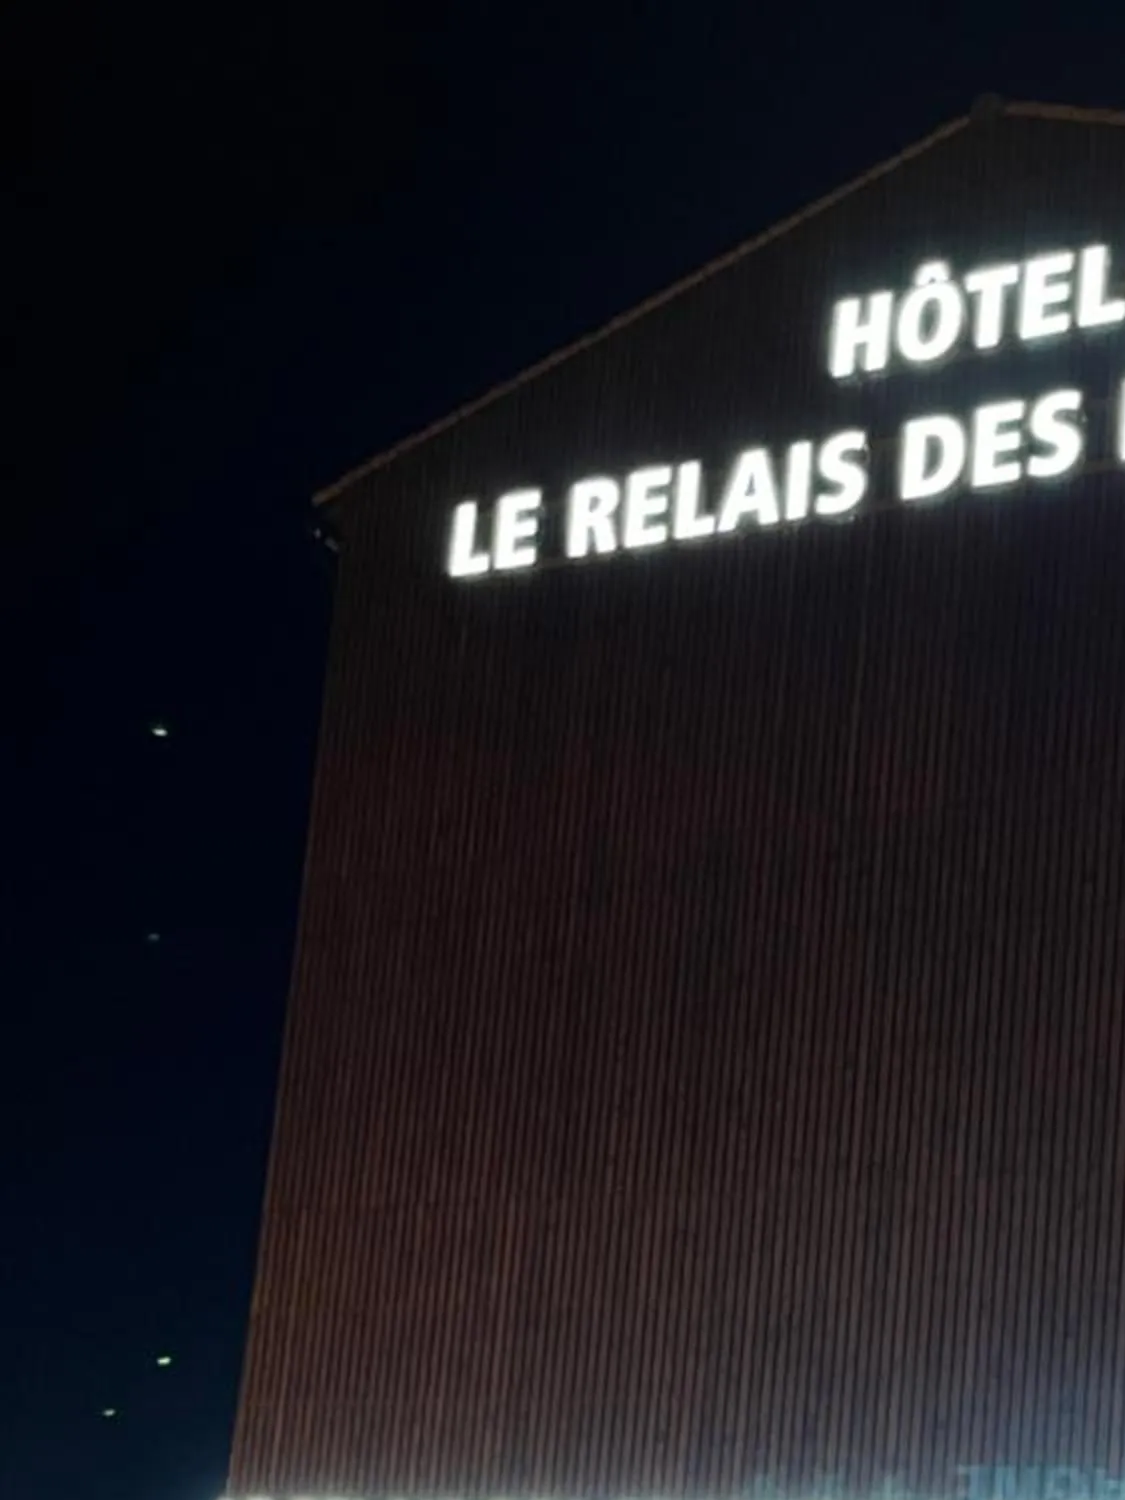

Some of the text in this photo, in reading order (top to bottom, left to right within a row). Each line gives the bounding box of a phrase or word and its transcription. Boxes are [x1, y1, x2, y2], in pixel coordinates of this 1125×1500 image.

[449, 490, 541, 576] LE
[567, 431, 866, 557] RELAIS
[900, 390, 1082, 500] DES
